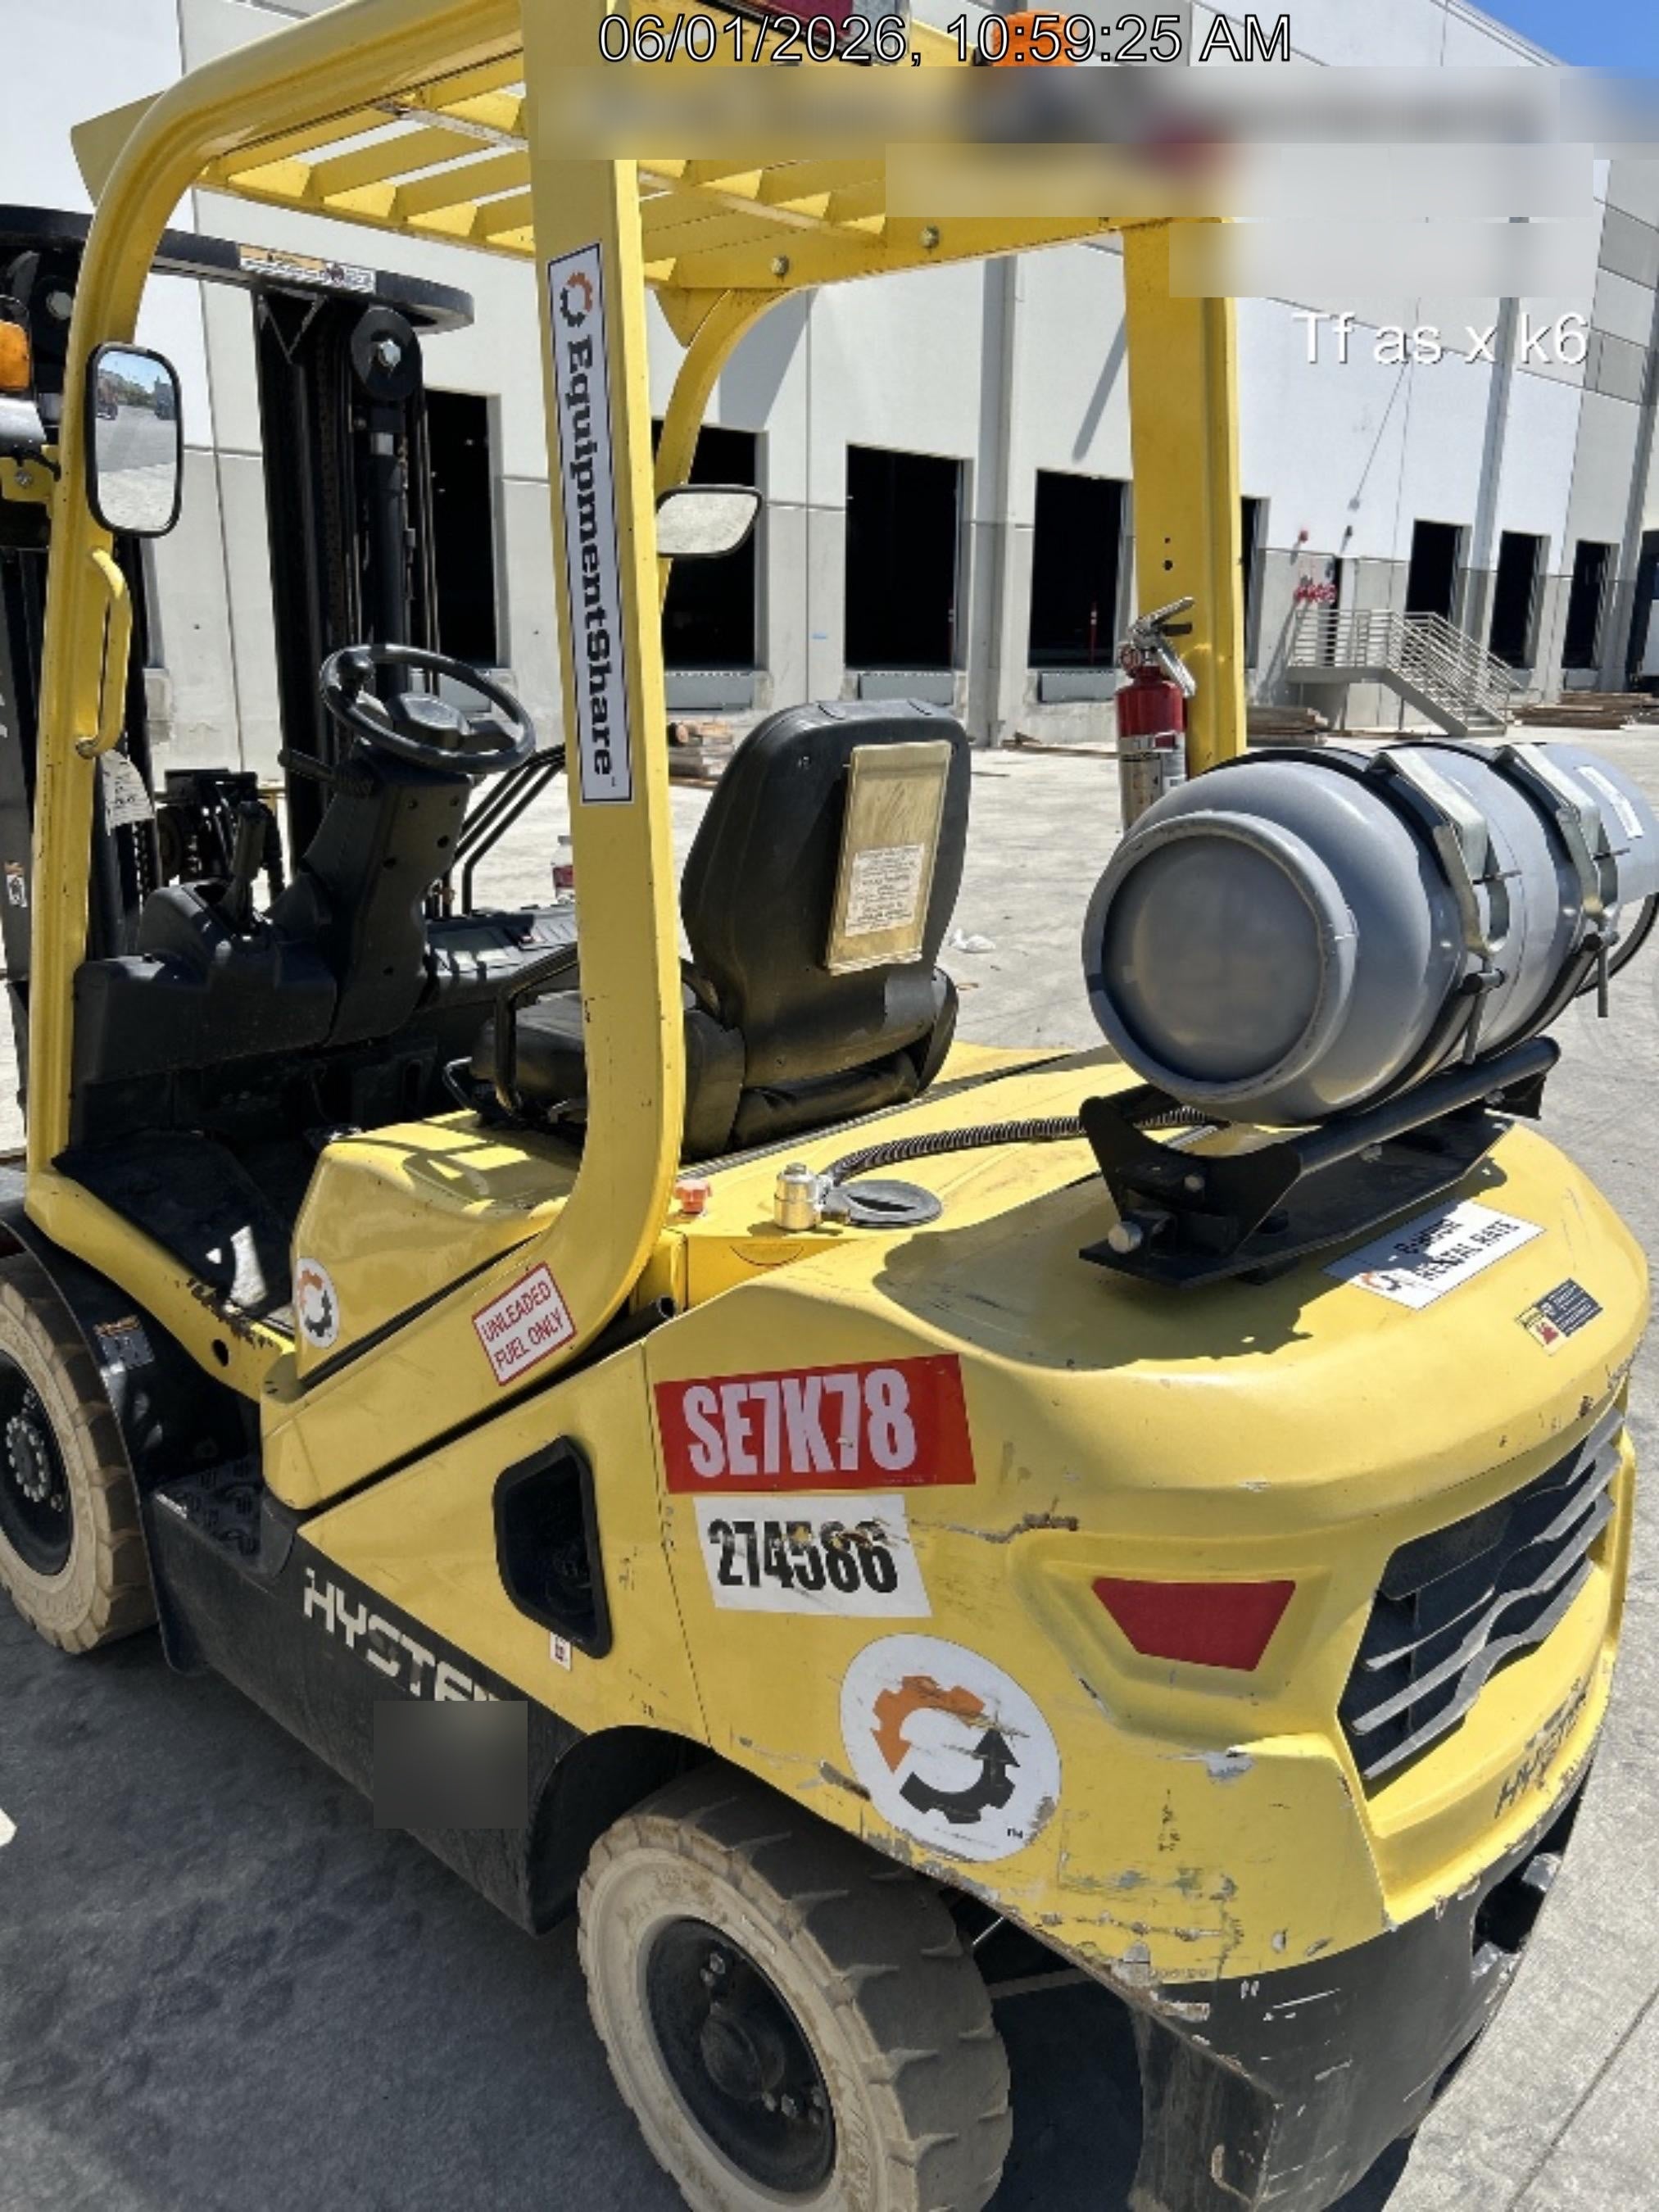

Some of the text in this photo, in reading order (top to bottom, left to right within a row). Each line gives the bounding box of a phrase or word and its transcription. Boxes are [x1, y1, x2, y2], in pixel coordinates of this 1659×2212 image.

[565, 334, 612, 775] EquipmentShare
[1470, 1219, 1521, 1247] RATE
[481, 1280, 551, 1342] UNLEADED
[493, 1307, 564, 1371] FUEL ONLY
[682, 1368, 917, 1477] SE7K78
[304, 1566, 501, 1702] HYSTE
